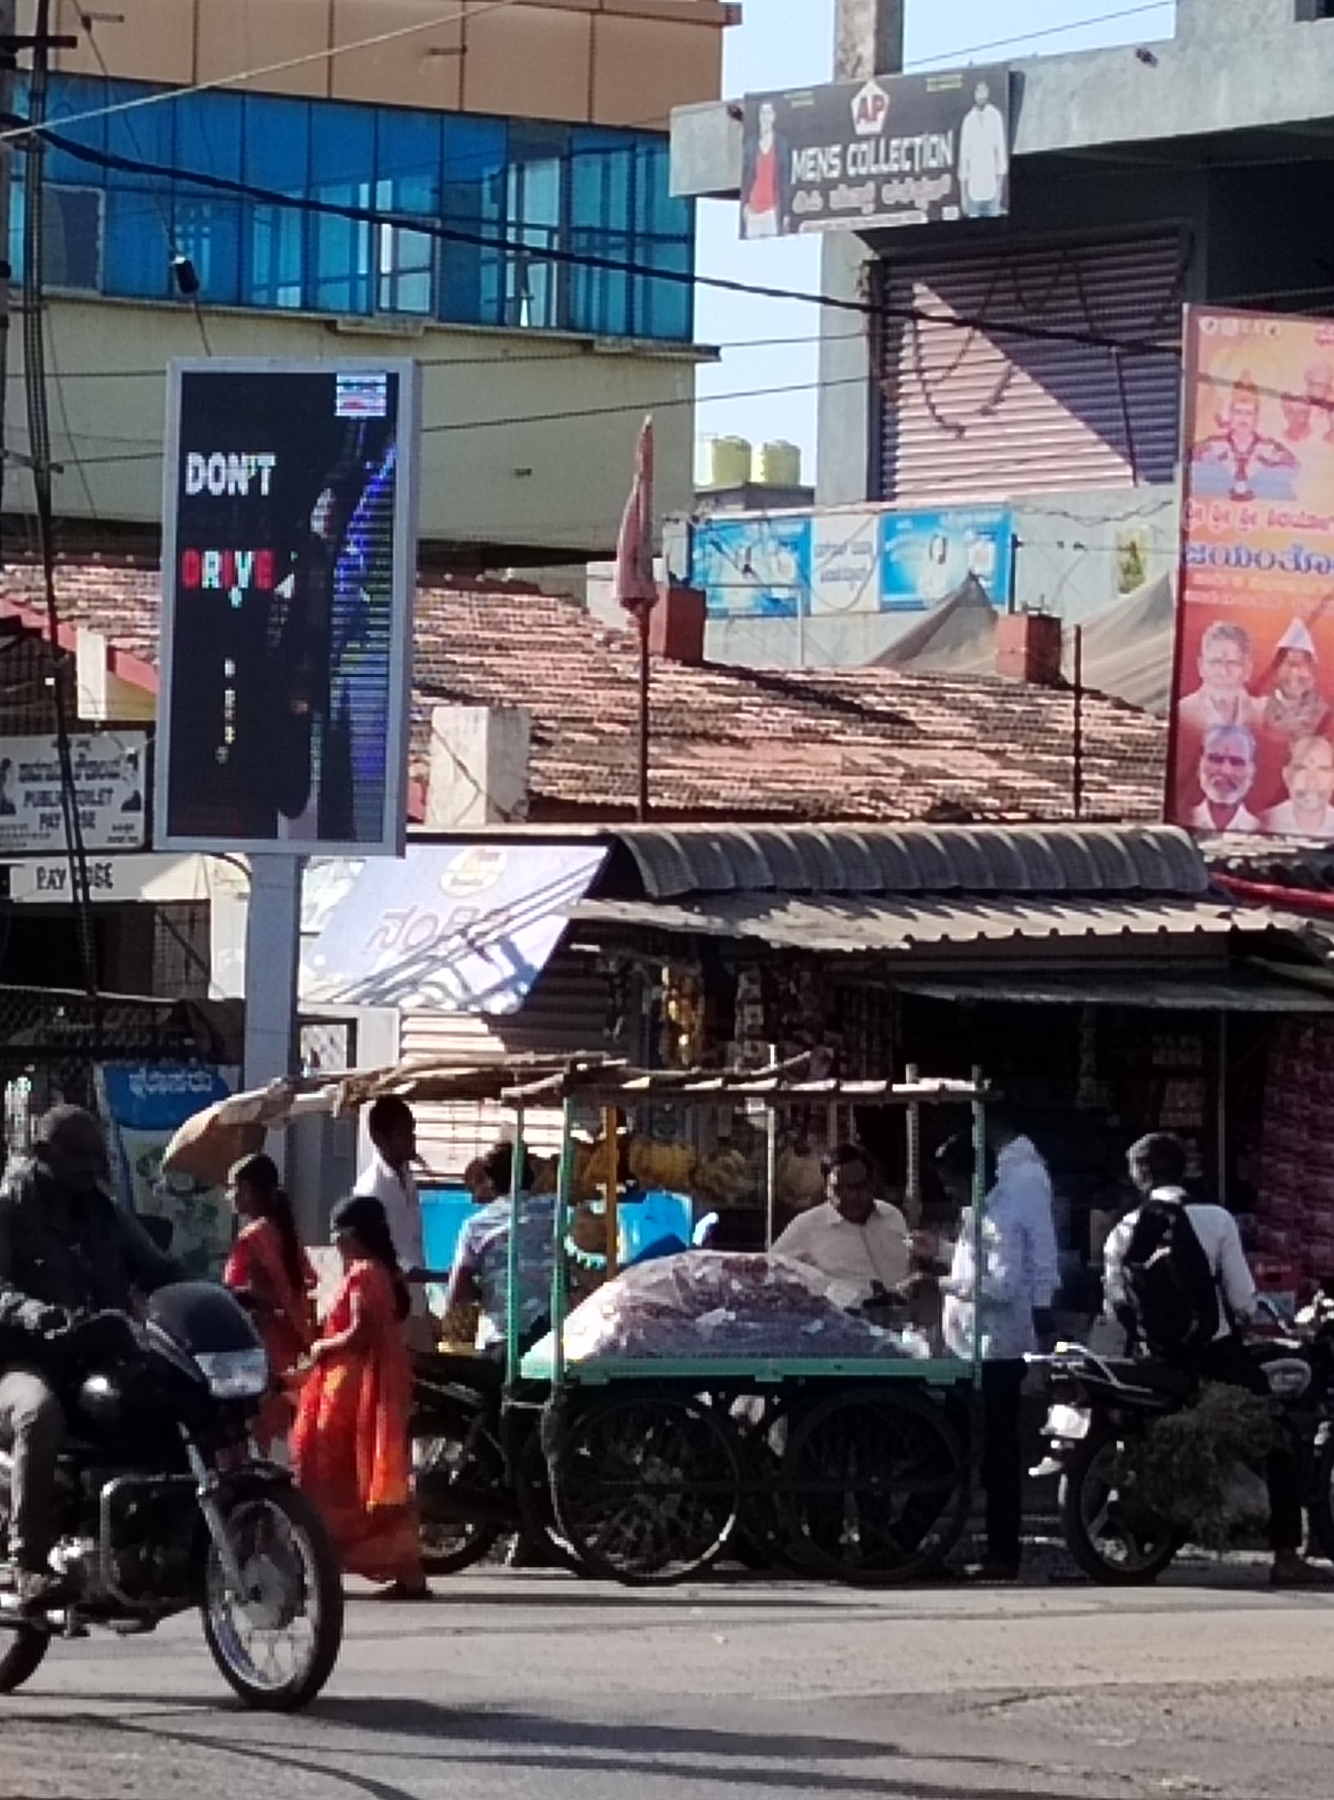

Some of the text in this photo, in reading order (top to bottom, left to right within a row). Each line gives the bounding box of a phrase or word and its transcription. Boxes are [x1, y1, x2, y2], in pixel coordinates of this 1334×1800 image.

[856, 94, 884, 124] AP
[791, 132, 953, 184] MENS COLLECTION
[185, 451, 277, 496] DON'T
[182, 550, 275, 589] DRIVE
[36, 865, 66, 890] PAY
